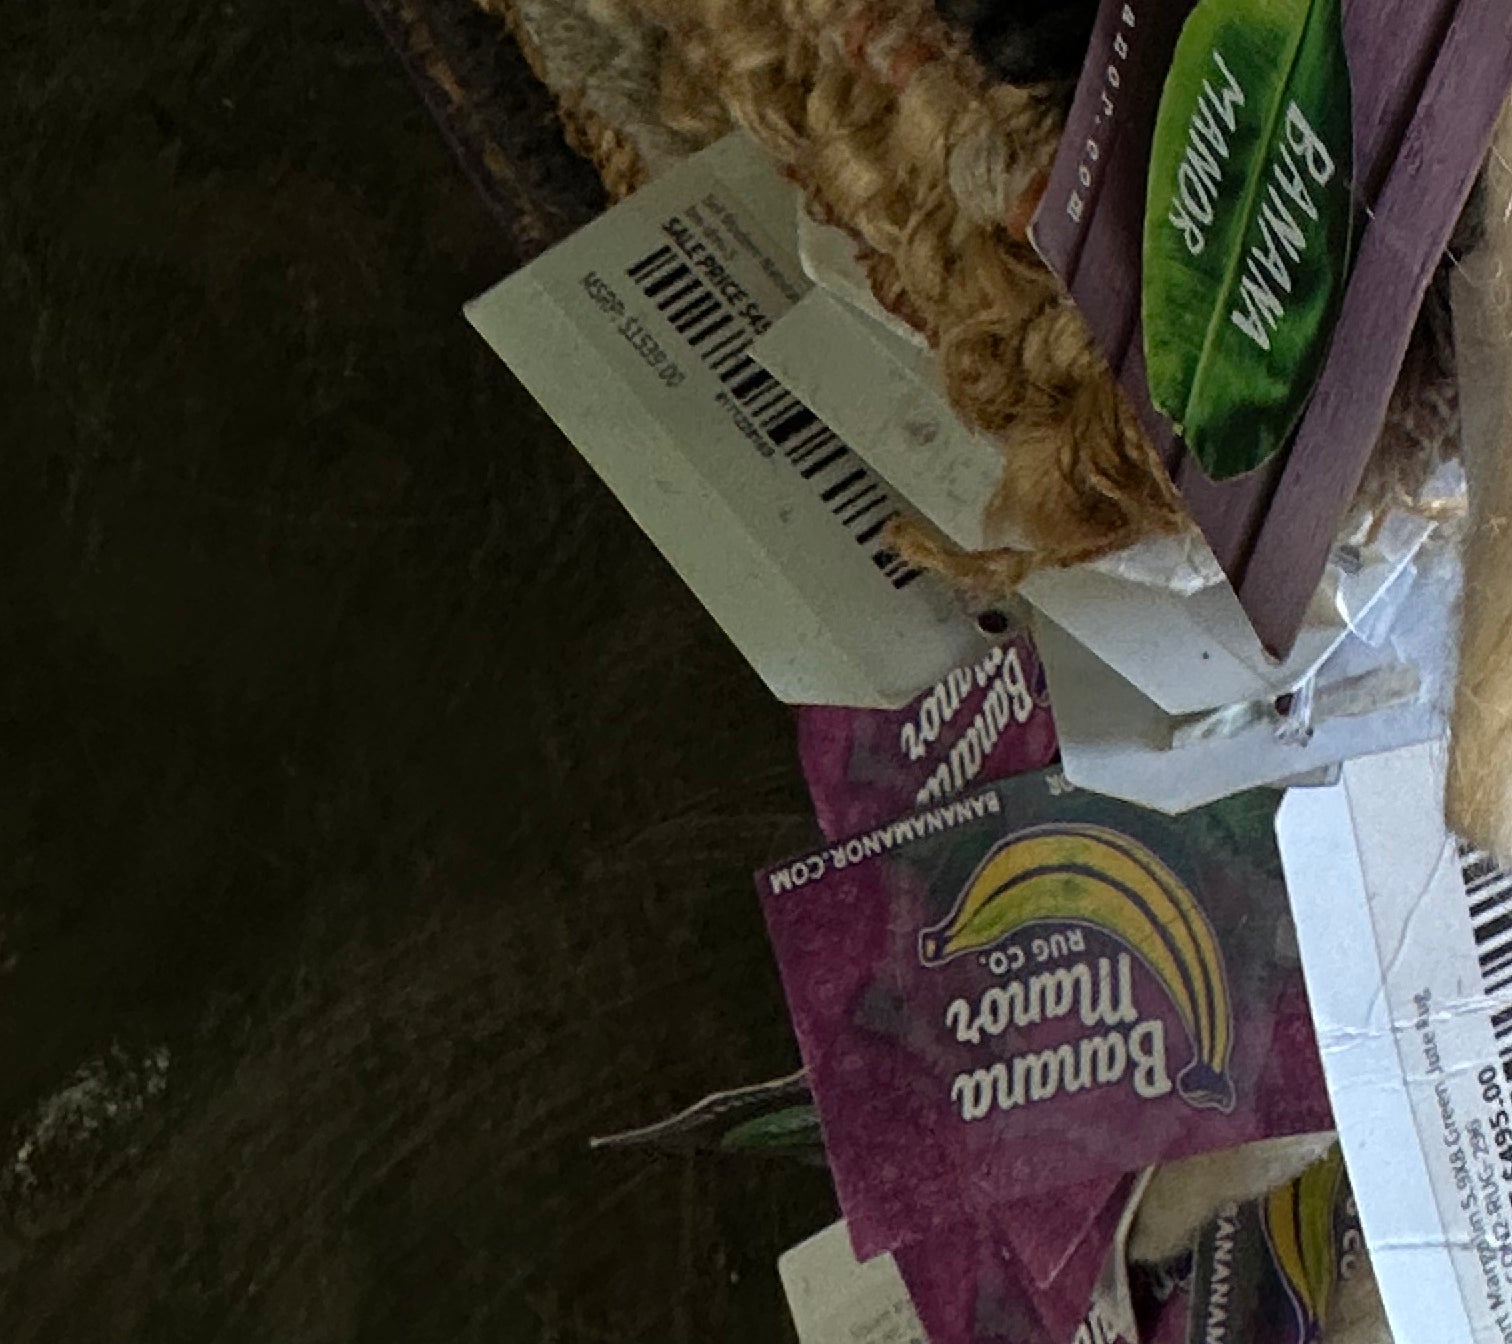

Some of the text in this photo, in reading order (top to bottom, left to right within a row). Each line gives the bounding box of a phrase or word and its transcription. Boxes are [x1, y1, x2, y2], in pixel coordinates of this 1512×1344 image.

[1168, 49, 1246, 256] MANOR
[1230, 99, 1336, 351] BANANA
[769, 790, 1000, 895] BANANAMANOR.COM
[945, 953, 1138, 1044] Manor
[978, 928, 1086, 976] RUG CO.
[951, 1019, 1172, 1121] Banana
